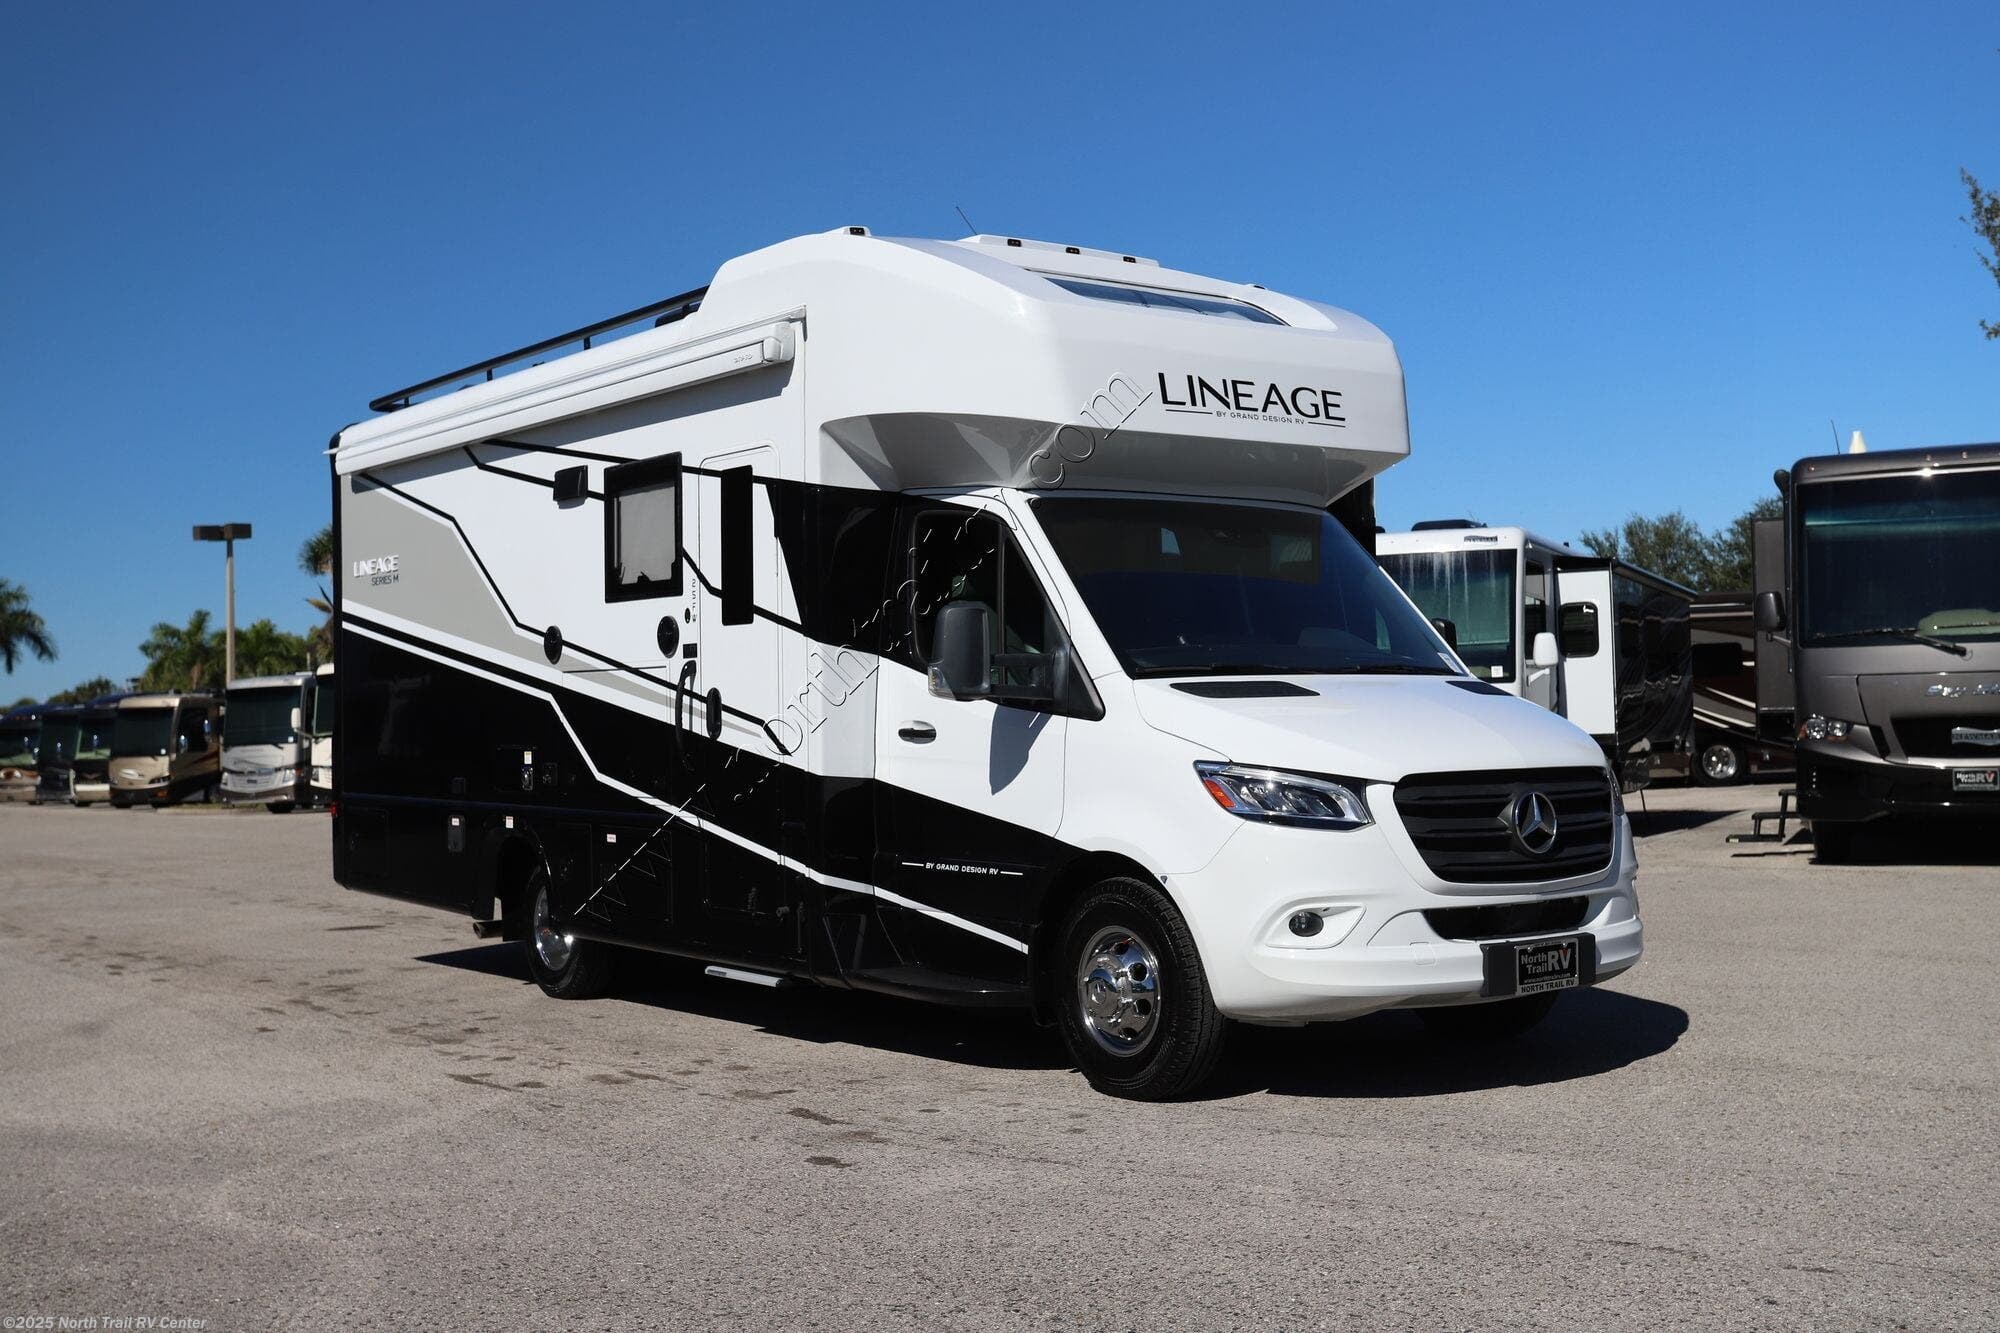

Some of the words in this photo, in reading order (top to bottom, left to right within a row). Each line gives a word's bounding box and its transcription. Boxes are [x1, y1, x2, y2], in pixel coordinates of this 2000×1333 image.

[1158, 372, 1346, 422] LINEAGE
[1230, 412, 1259, 421] GRAND
[1262, 415, 1293, 425] DESIGN
[353, 555, 399, 577] LINEAGE
[371, 575, 392, 586] SERIES
[936, 863, 959, 872] GRAND
[961, 865, 987, 874] DESIGN
[1521, 952, 1547, 965] North
[1547, 947, 1571, 972] RV
[1526, 962, 1547, 974] Trail
[1520, 984, 1543, 993] NORTH
[1545, 981, 1564, 989] TRAIL
